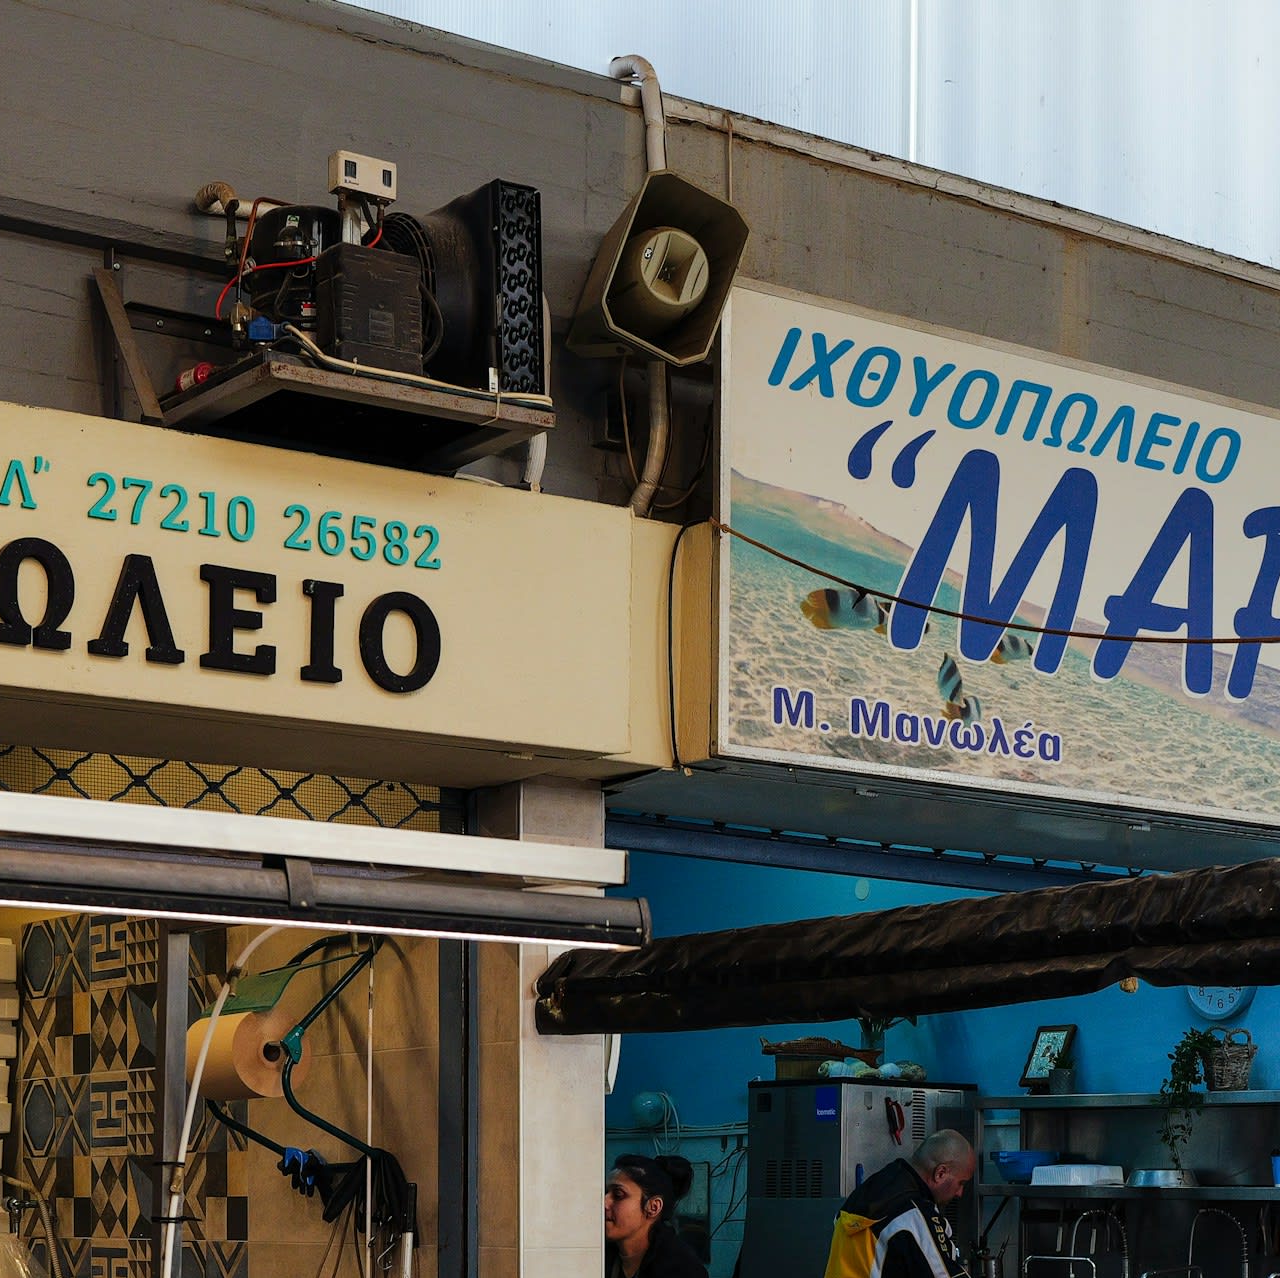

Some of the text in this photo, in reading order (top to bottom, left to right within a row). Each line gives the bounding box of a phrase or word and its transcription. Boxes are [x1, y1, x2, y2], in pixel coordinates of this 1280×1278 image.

[767, 327, 1242, 484] ΙΧΘΥΟΠΩΛΕΙΟ
[87, 473, 257, 543] 27210
[283, 504, 442, 571] 26582
[772, 687, 1063, 762] Μ. Μανωλέα
[1217, 998, 1224, 1009] 6
[1228, 992, 1235, 1004] 5
